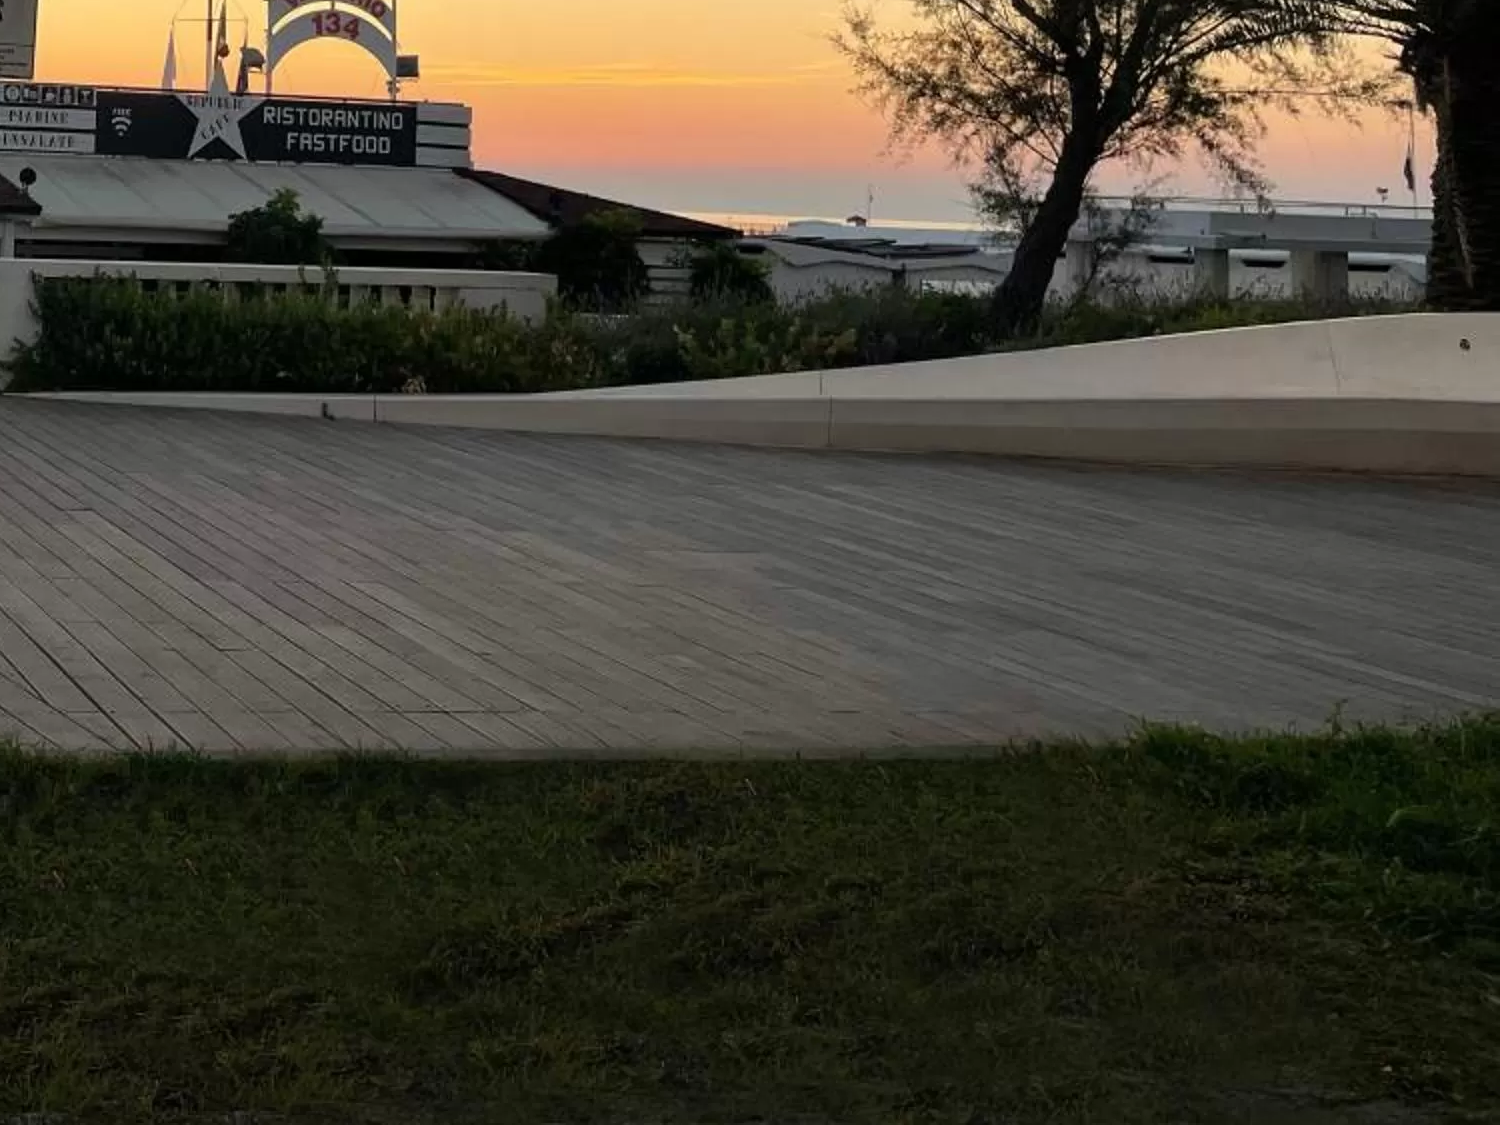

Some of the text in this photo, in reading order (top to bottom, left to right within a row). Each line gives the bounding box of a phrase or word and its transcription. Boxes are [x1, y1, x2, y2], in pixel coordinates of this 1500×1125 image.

[311, 13, 360, 40] 134
[263, 106, 404, 131] RISTORANTINO
[286, 132, 392, 155] FASTFOOD
